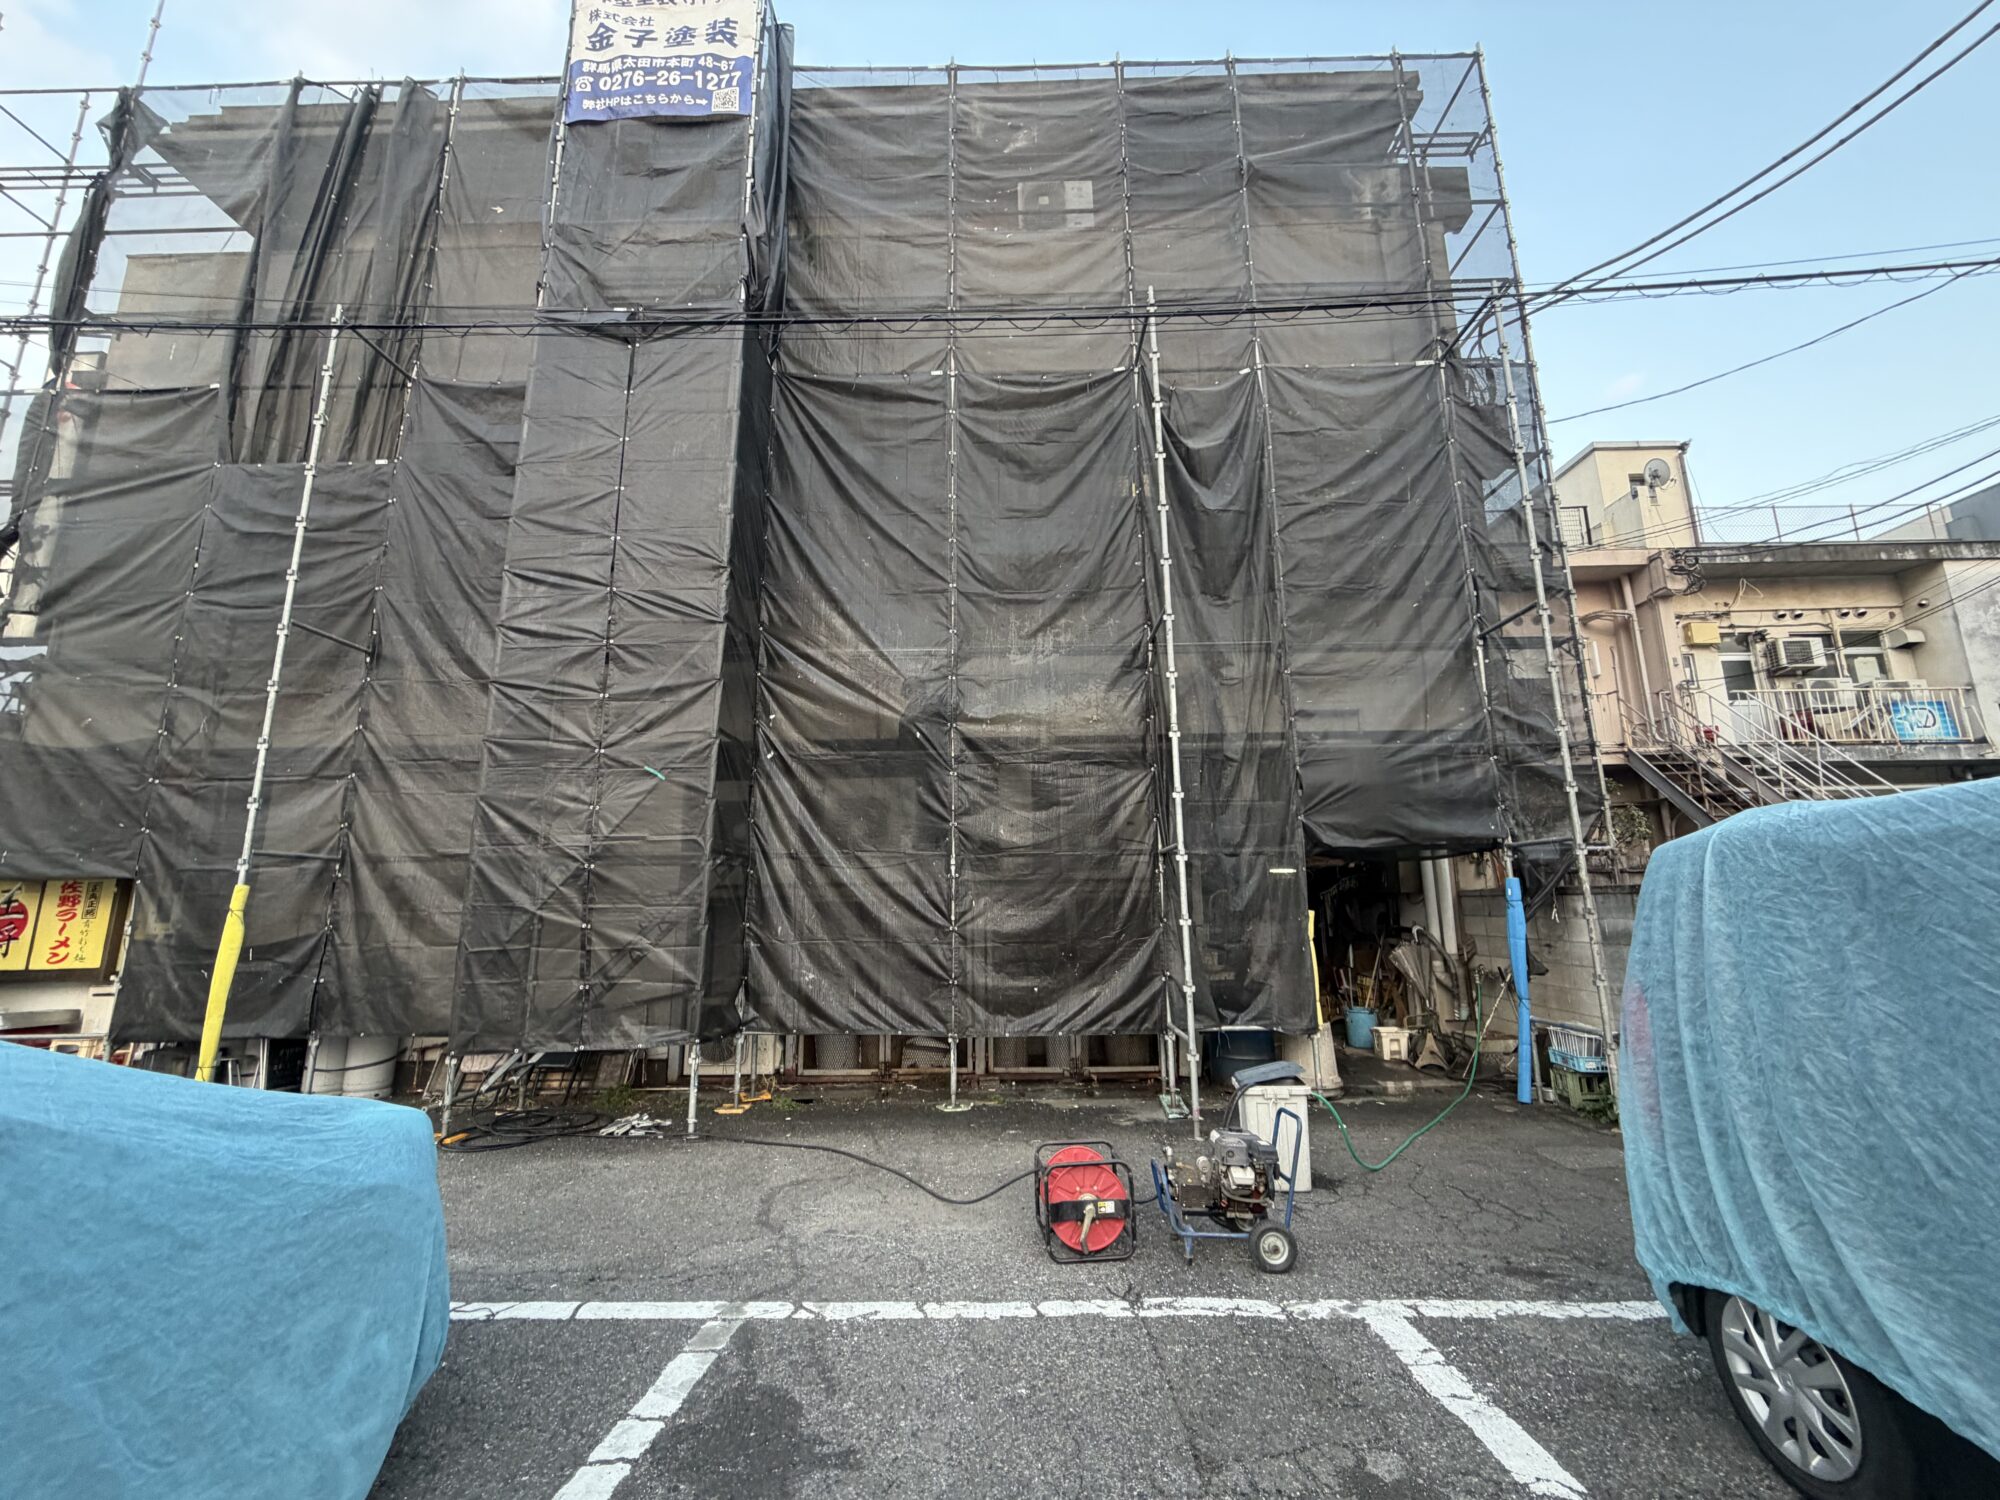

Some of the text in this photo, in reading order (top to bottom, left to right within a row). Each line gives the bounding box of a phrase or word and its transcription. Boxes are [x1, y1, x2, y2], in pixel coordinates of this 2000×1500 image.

[589, 8, 655, 27] 株式会社
[585, 17, 739, 51] 金子塗装
[599, 70, 742, 91] 0276-26-1277
[46, 880, 84, 965] 佐野ラーメン
